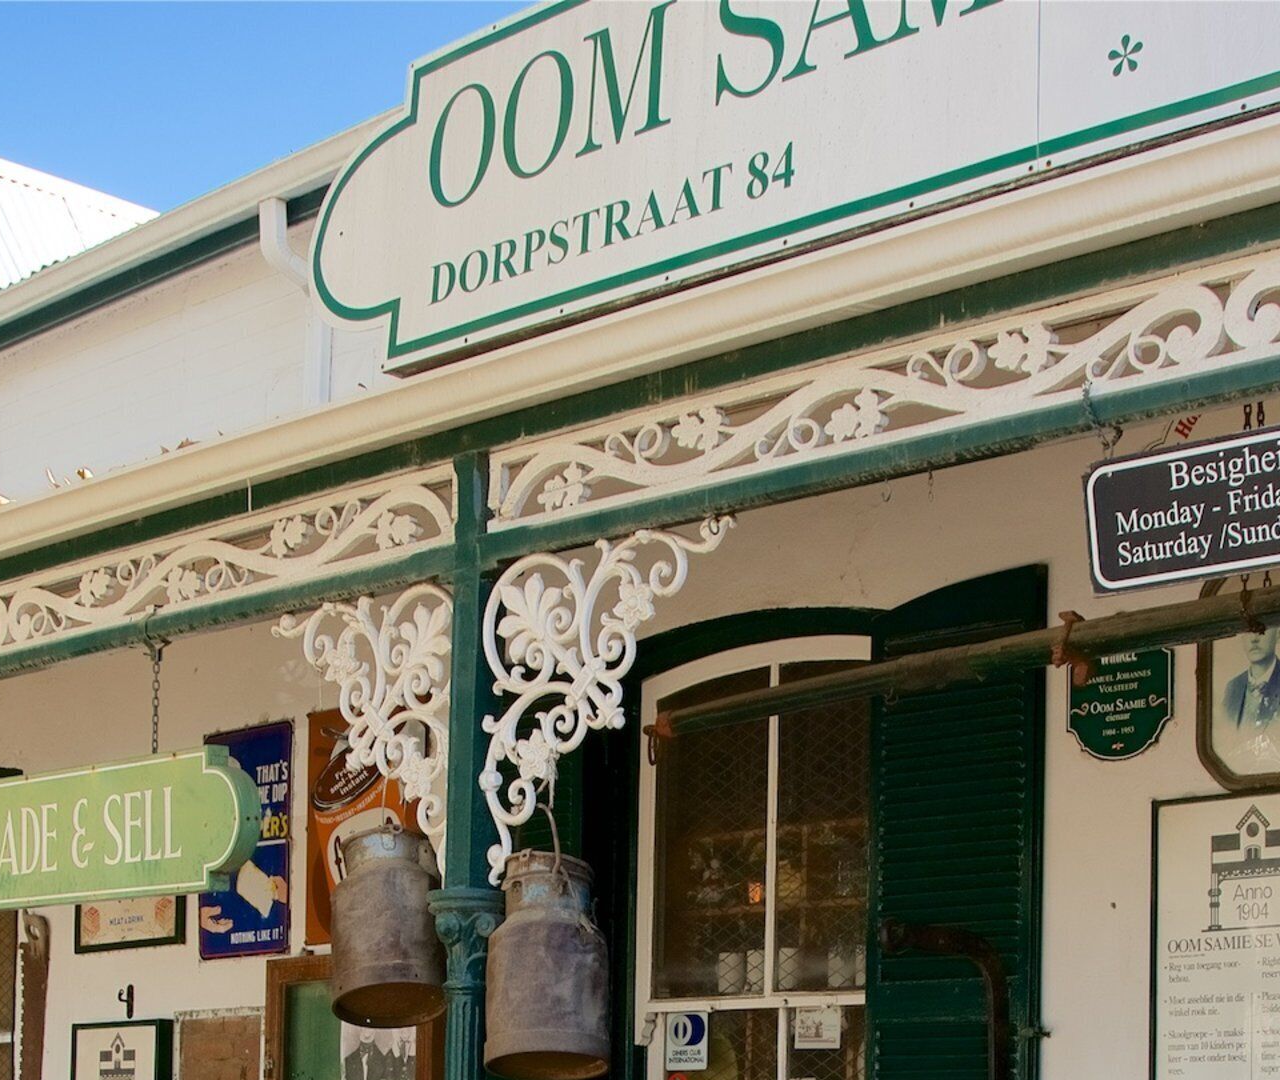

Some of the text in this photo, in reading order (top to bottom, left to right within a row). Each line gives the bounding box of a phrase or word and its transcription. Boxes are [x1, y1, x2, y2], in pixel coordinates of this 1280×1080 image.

[429, 0, 1005, 208] OOM SA
[429, 141, 794, 305] DORPSTRAAT 84
[1115, 500, 1205, 535] Monday
[1118, 531, 1212, 566] Saturday
[255, 760, 288, 785] THAT'S
[71, 796, 95, 870] &
[103, 786, 182, 868] SELL
[1233, 884, 1273, 901] Anno
[1235, 902, 1270, 920] 1904
[1167, 938, 1202, 954] OOM
[1204, 934, 1252, 952] SAMIE
[1254, 933, 1273, 949] SE
